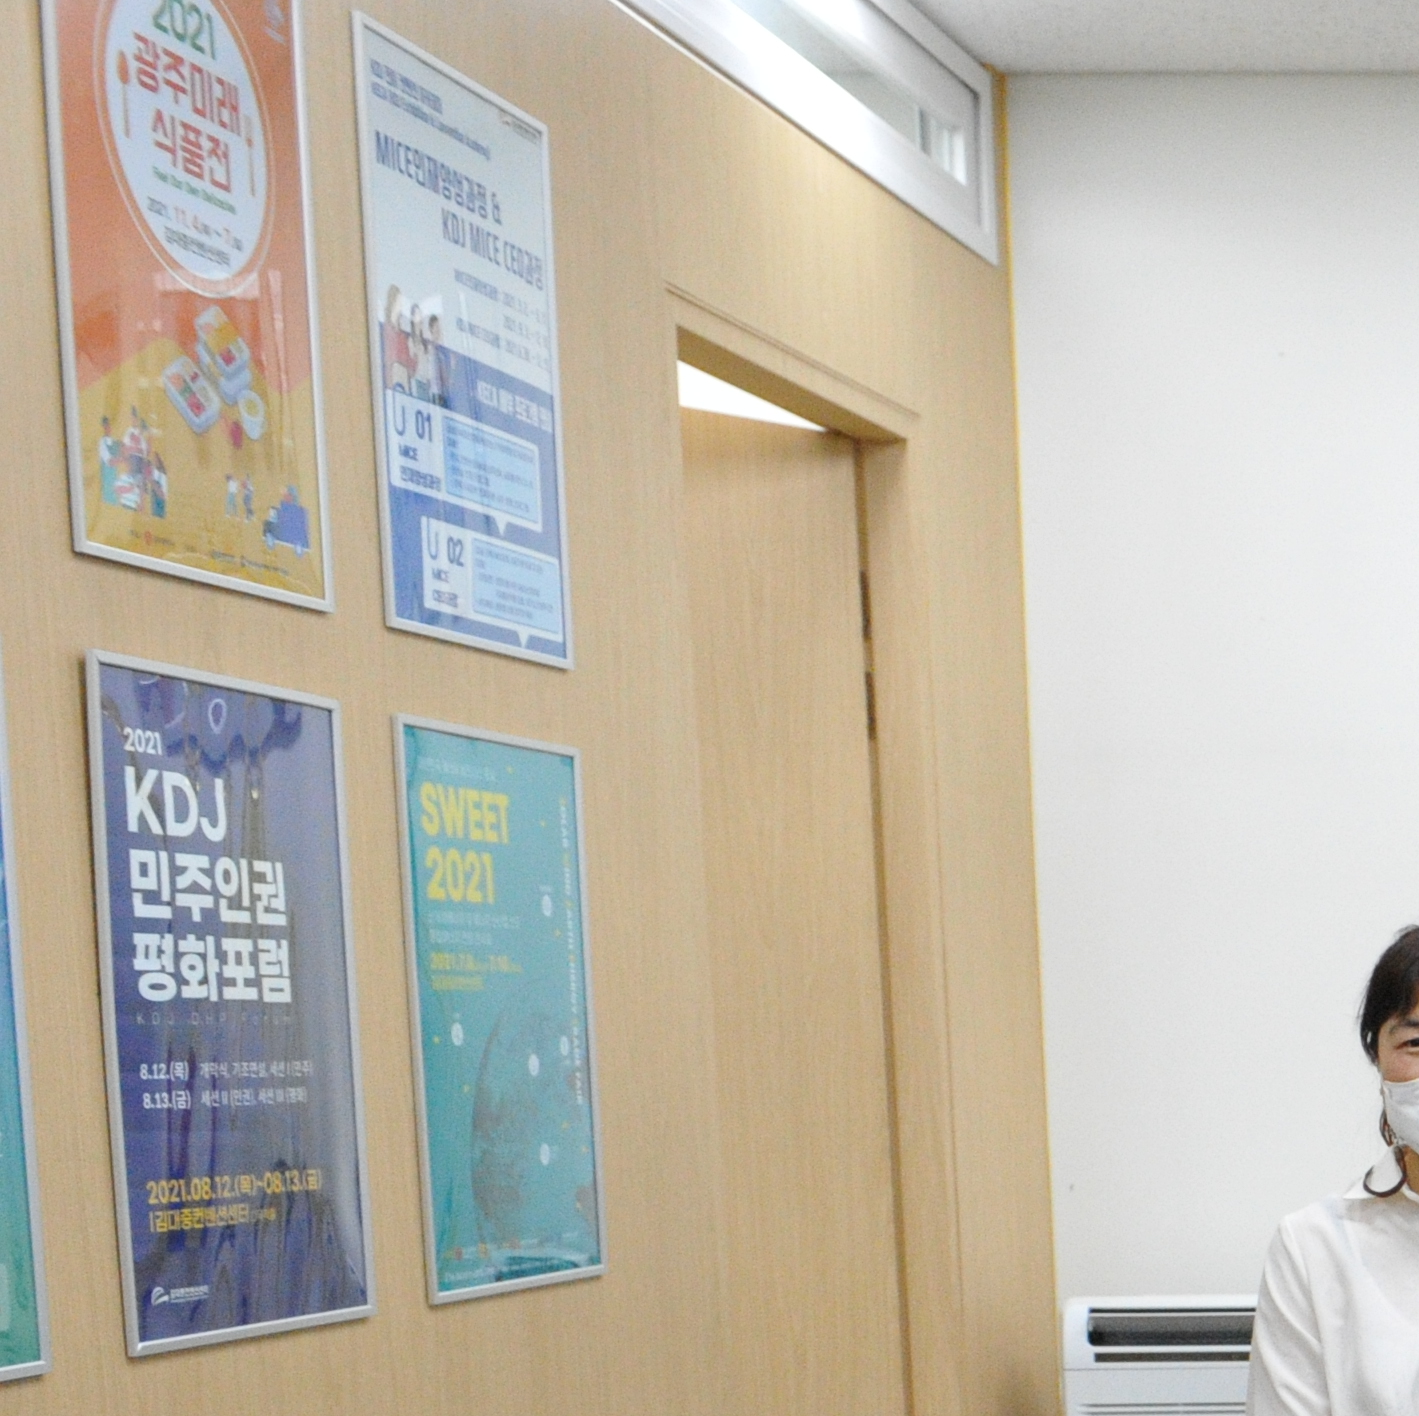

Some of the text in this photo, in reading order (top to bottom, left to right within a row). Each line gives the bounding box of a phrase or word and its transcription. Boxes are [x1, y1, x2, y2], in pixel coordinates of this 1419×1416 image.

[133, 31, 241, 137] 광주미래
[152, 108, 232, 194] 식품전
[441, 206, 467, 249] KDJ
[469, 221, 501, 267] MICE
[415, 408, 433, 443] 01
[447, 534, 465, 568] 02
[123, 727, 163, 756] 2021
[124, 765, 227, 842] KDJ
[420, 781, 510, 844] SWEET
[129, 849, 287, 926] 민주인권
[425, 846, 495, 905] 2021
[133, 932, 292, 1003] 평화포럼
